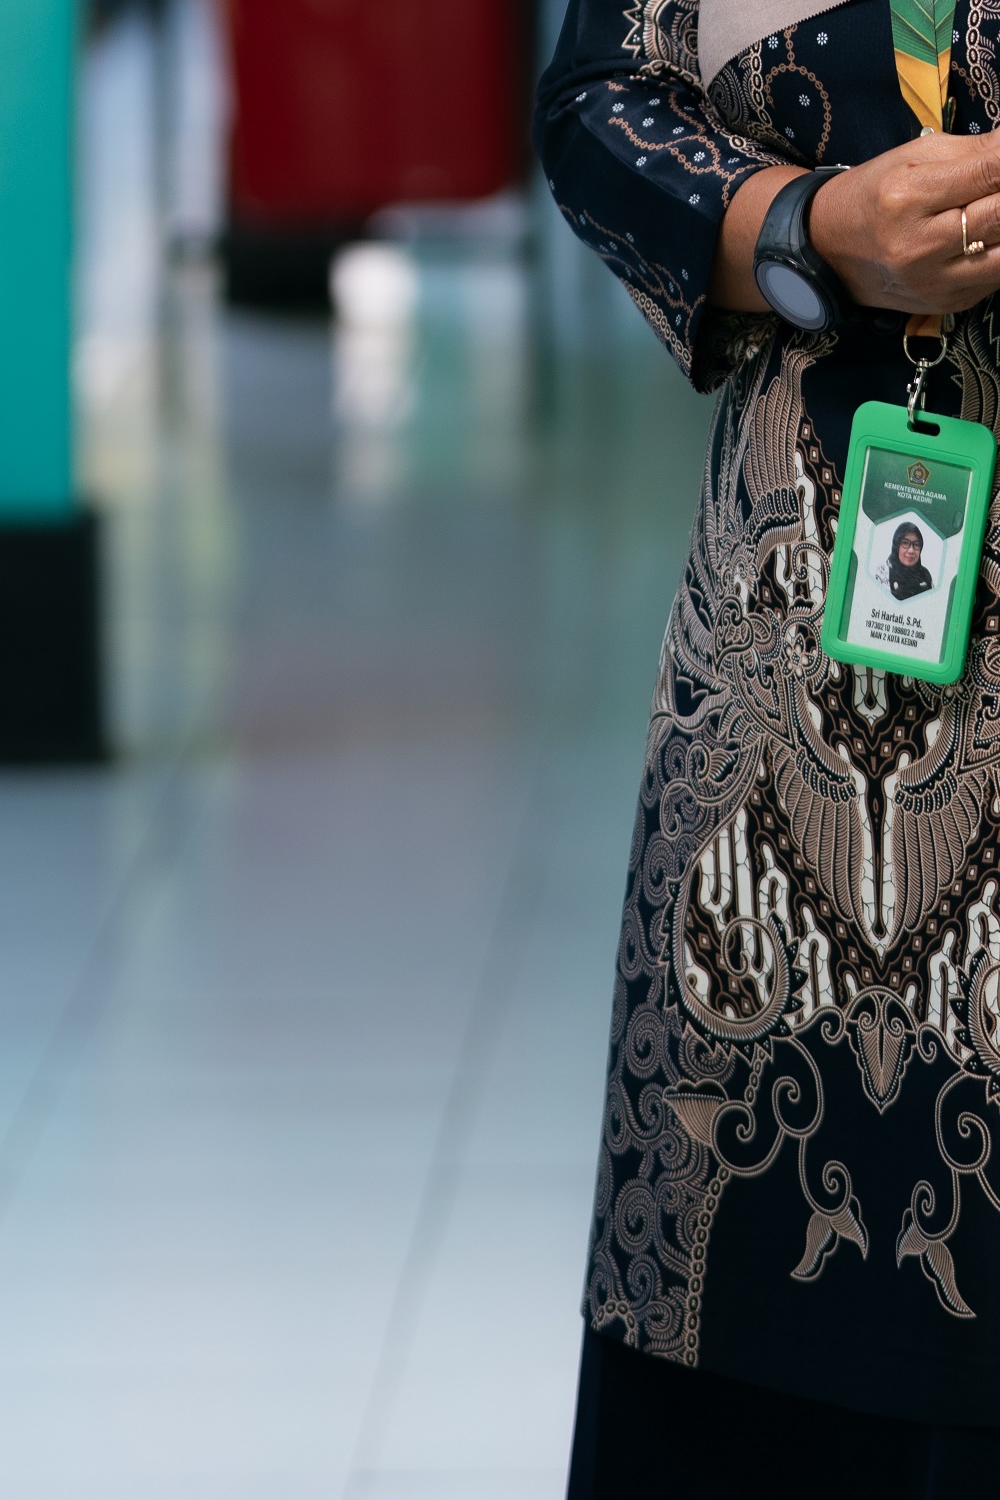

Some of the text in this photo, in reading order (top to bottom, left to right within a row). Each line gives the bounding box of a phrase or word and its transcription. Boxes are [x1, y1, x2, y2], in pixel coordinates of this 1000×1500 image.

[884, 481, 947, 501] KEMENTERIAN AGAMA
[897, 491, 933, 504] KOTA KEDIRI
[871, 608, 922, 628] Sri Hartati, S.Pd.
[870, 630, 918, 648] MAN 2 KOTA KEDIRI
[911, 630, 915, 638] 2
